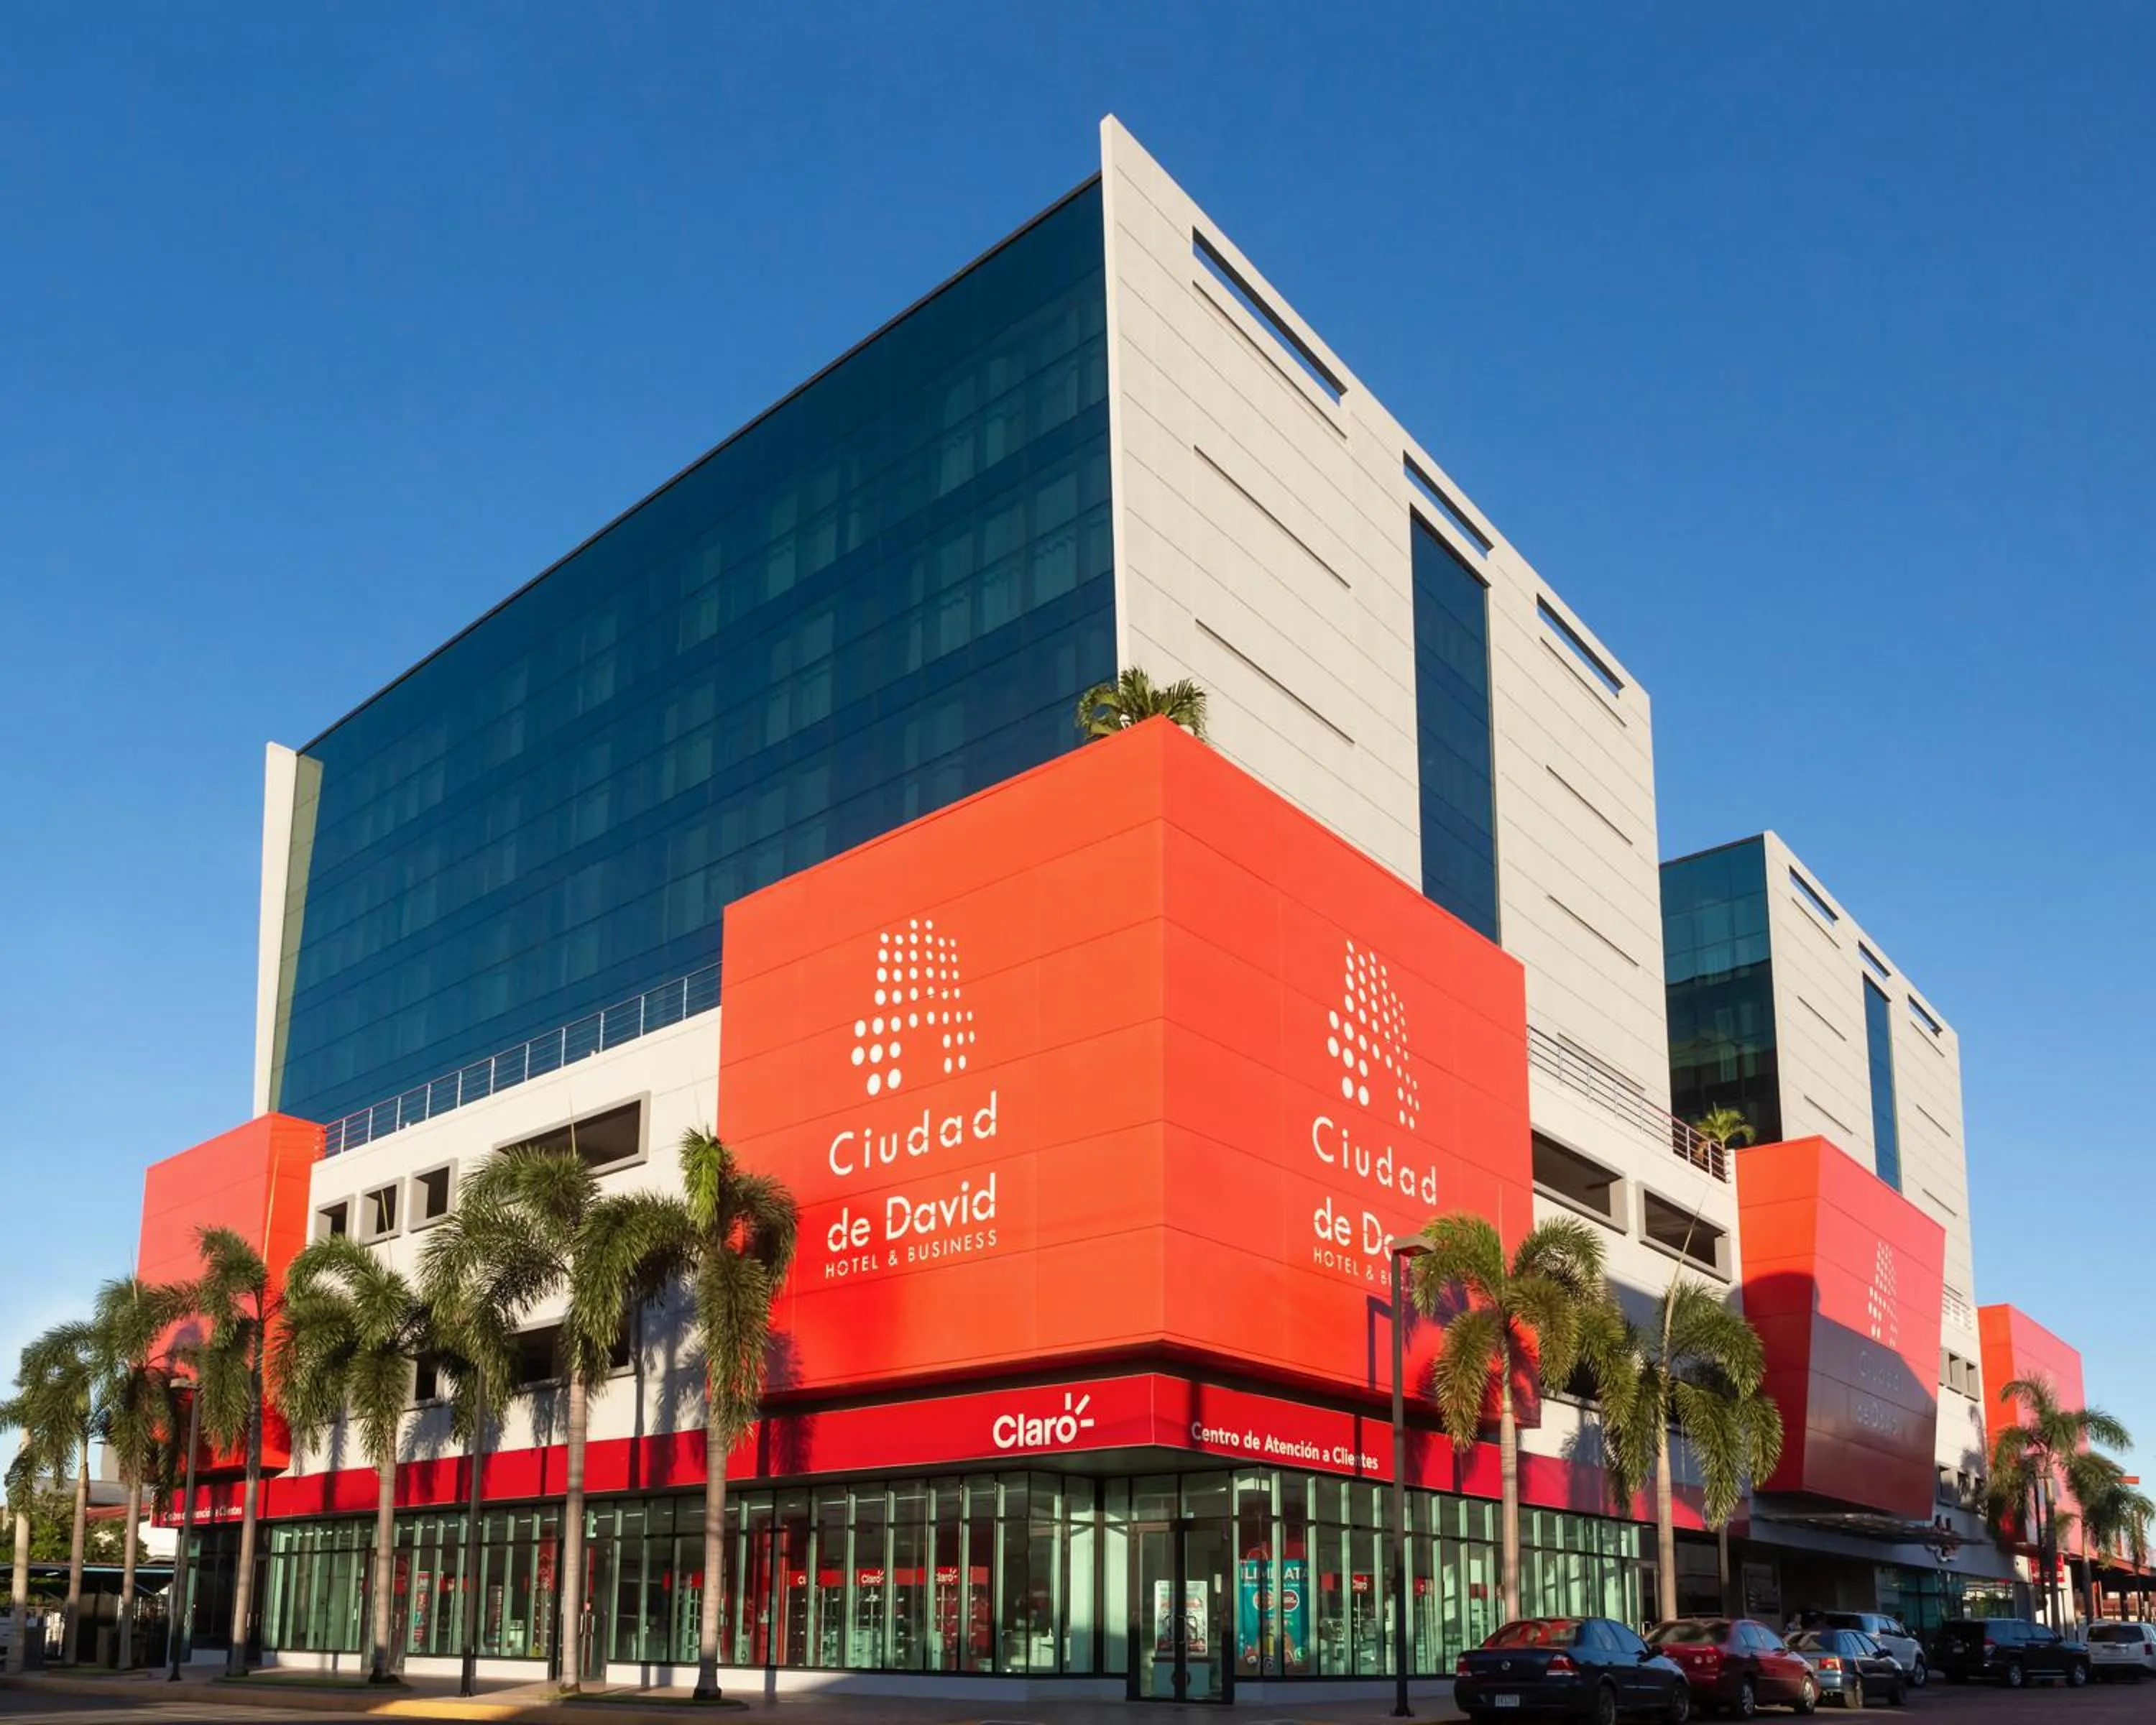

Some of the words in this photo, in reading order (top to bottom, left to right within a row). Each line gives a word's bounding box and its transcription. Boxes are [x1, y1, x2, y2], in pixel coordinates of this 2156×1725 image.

[829, 1090, 997, 1175] Ciudad
[1312, 1116, 1437, 1205] Ciudad
[828, 1208, 871, 1252] de
[886, 1172, 995, 1240] David
[1314, 1196, 1352, 1246] de
[825, 1255, 879, 1279] HOTEL
[888, 1250, 898, 1266] &
[908, 1229, 997, 1262] BUSINESS
[1313, 1246, 1359, 1276] HOTEL
[1367, 1264, 1374, 1280] &
[992, 1412, 1077, 1448] Claro
[1191, 1421, 1240, 1446] Centro
[1243, 1430, 1260, 1450] de
[1264, 1434, 1319, 1460] Atención
[1322, 1449, 1330, 1462] a
[1332, 1446, 1378, 1470] Clientes
